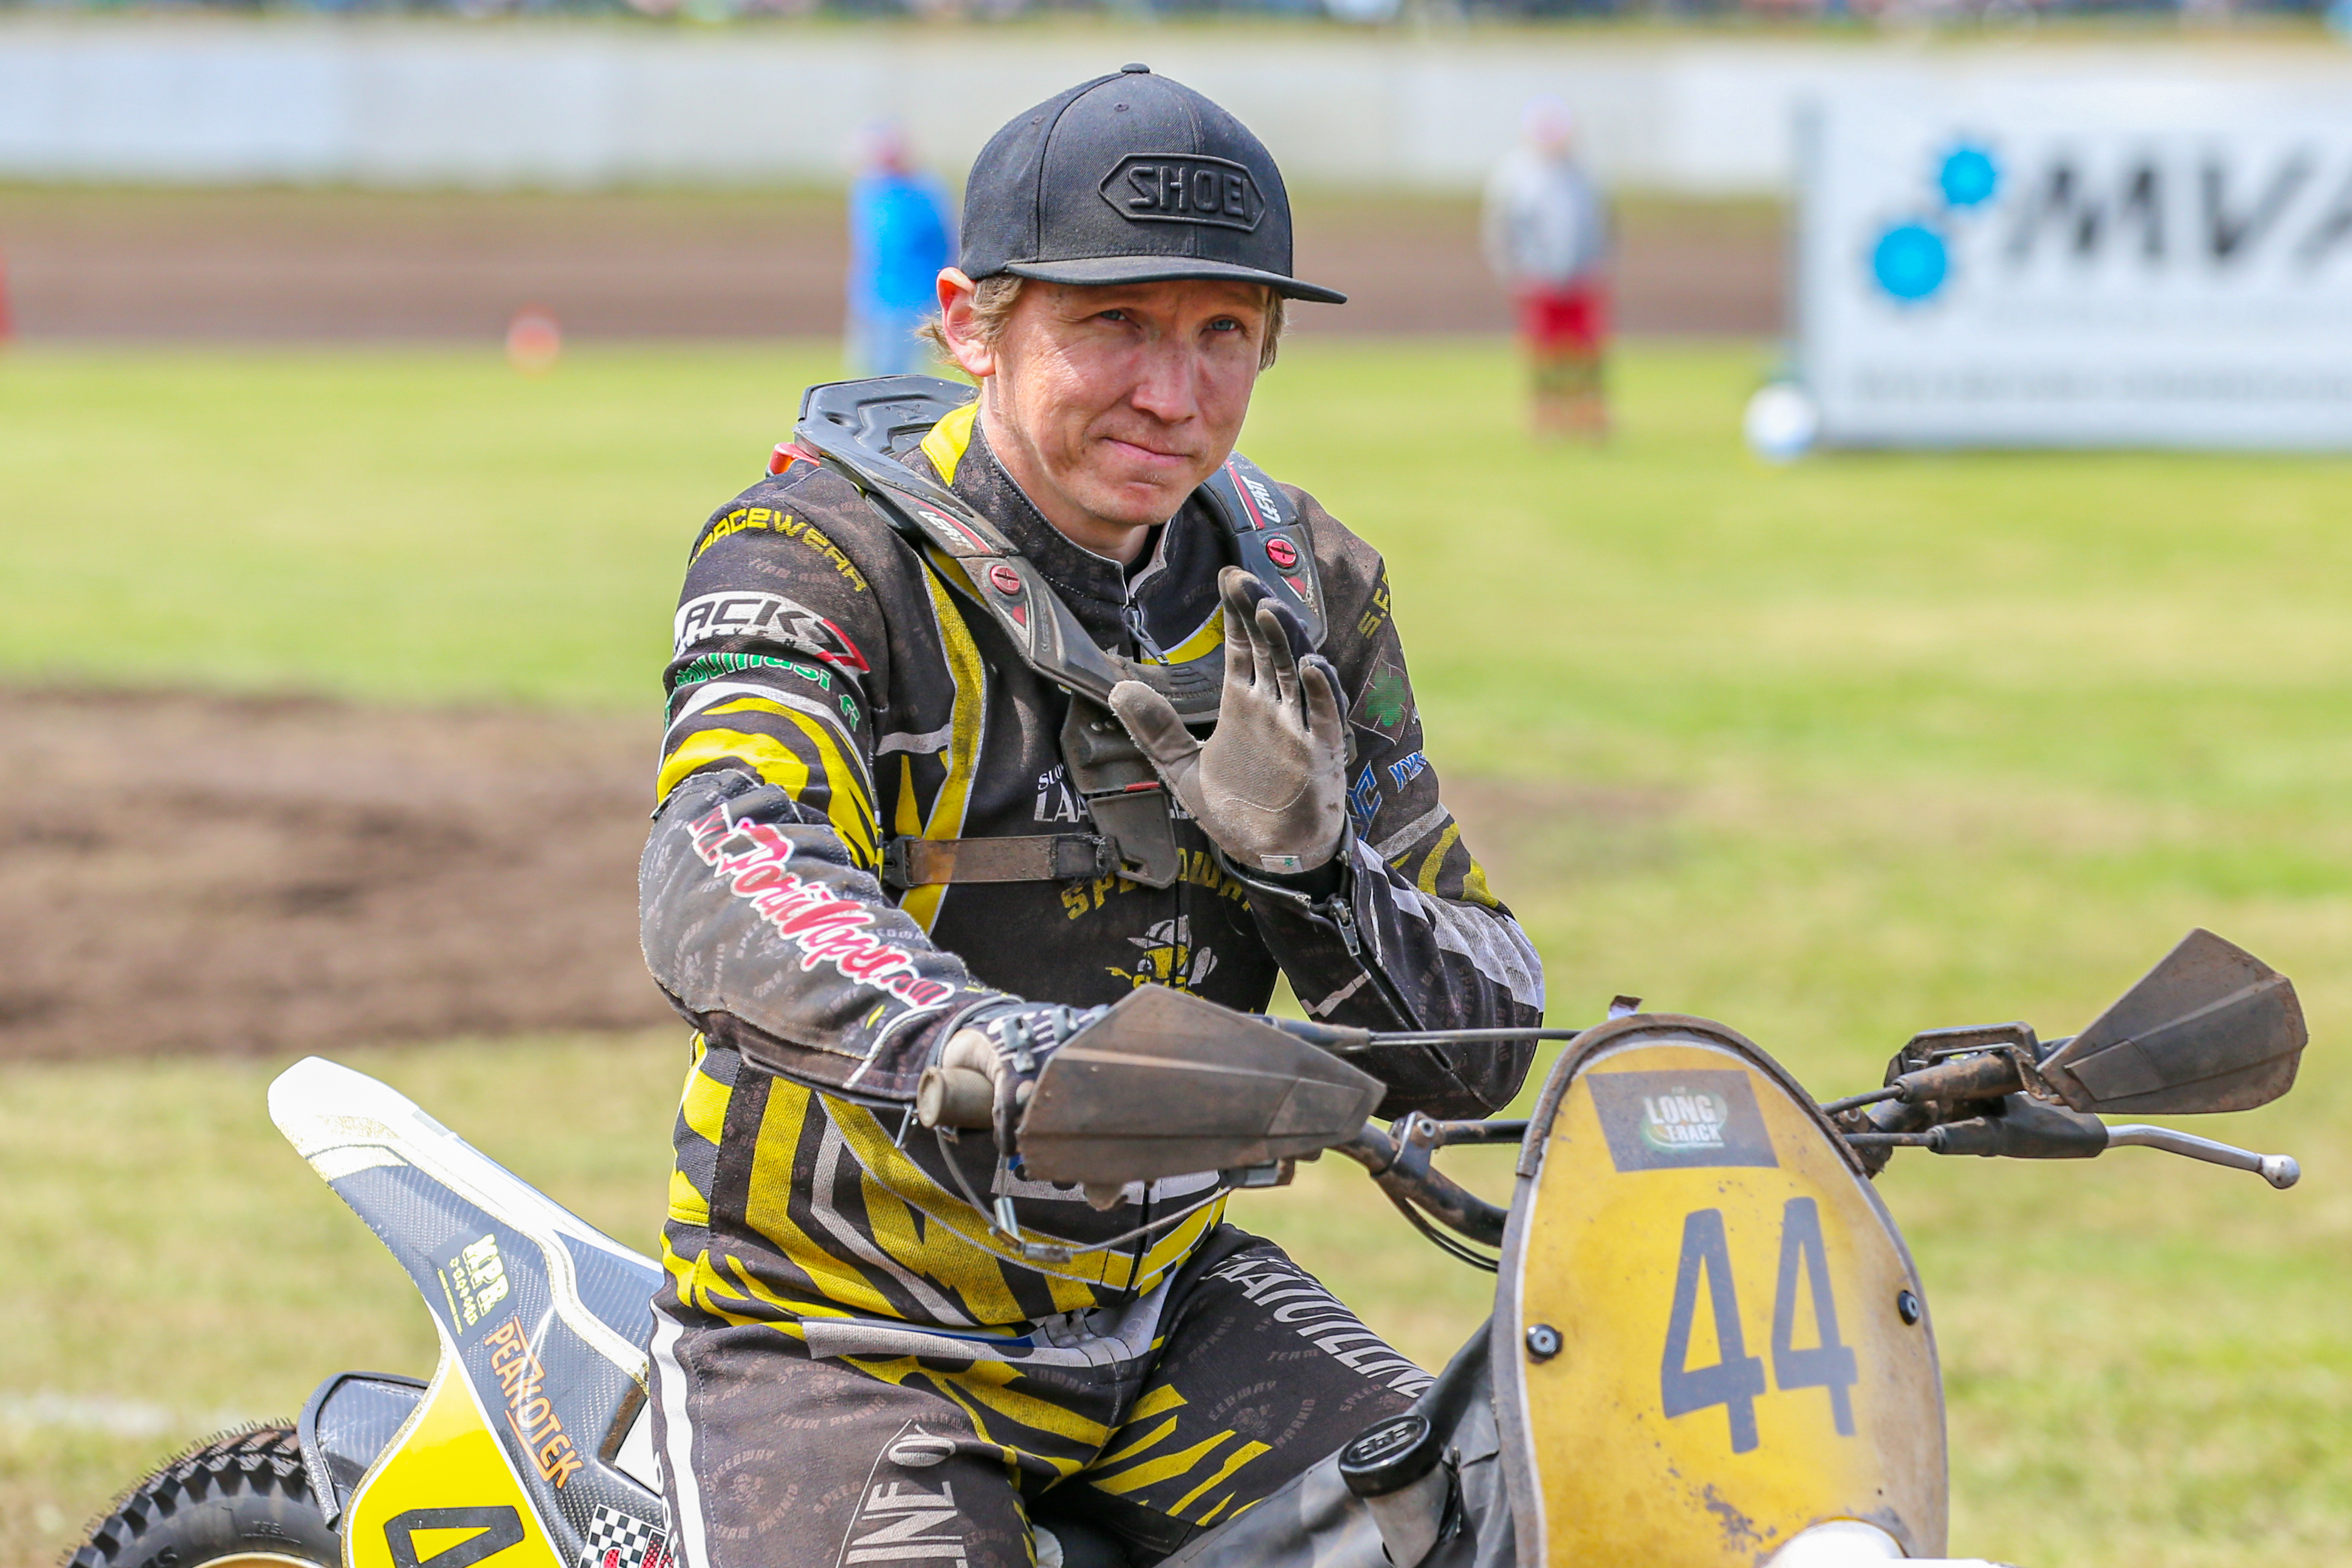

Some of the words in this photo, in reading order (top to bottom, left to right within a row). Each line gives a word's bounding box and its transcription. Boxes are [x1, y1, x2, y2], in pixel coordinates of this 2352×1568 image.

[1127, 165, 1254, 221] SHOEI
[1643, 1094, 1716, 1126] LONG
[1664, 1123, 1722, 1143] TRACK
[1660, 1196, 1859, 1456] 44
[483, 1315, 585, 1490] PEAKOTEK
